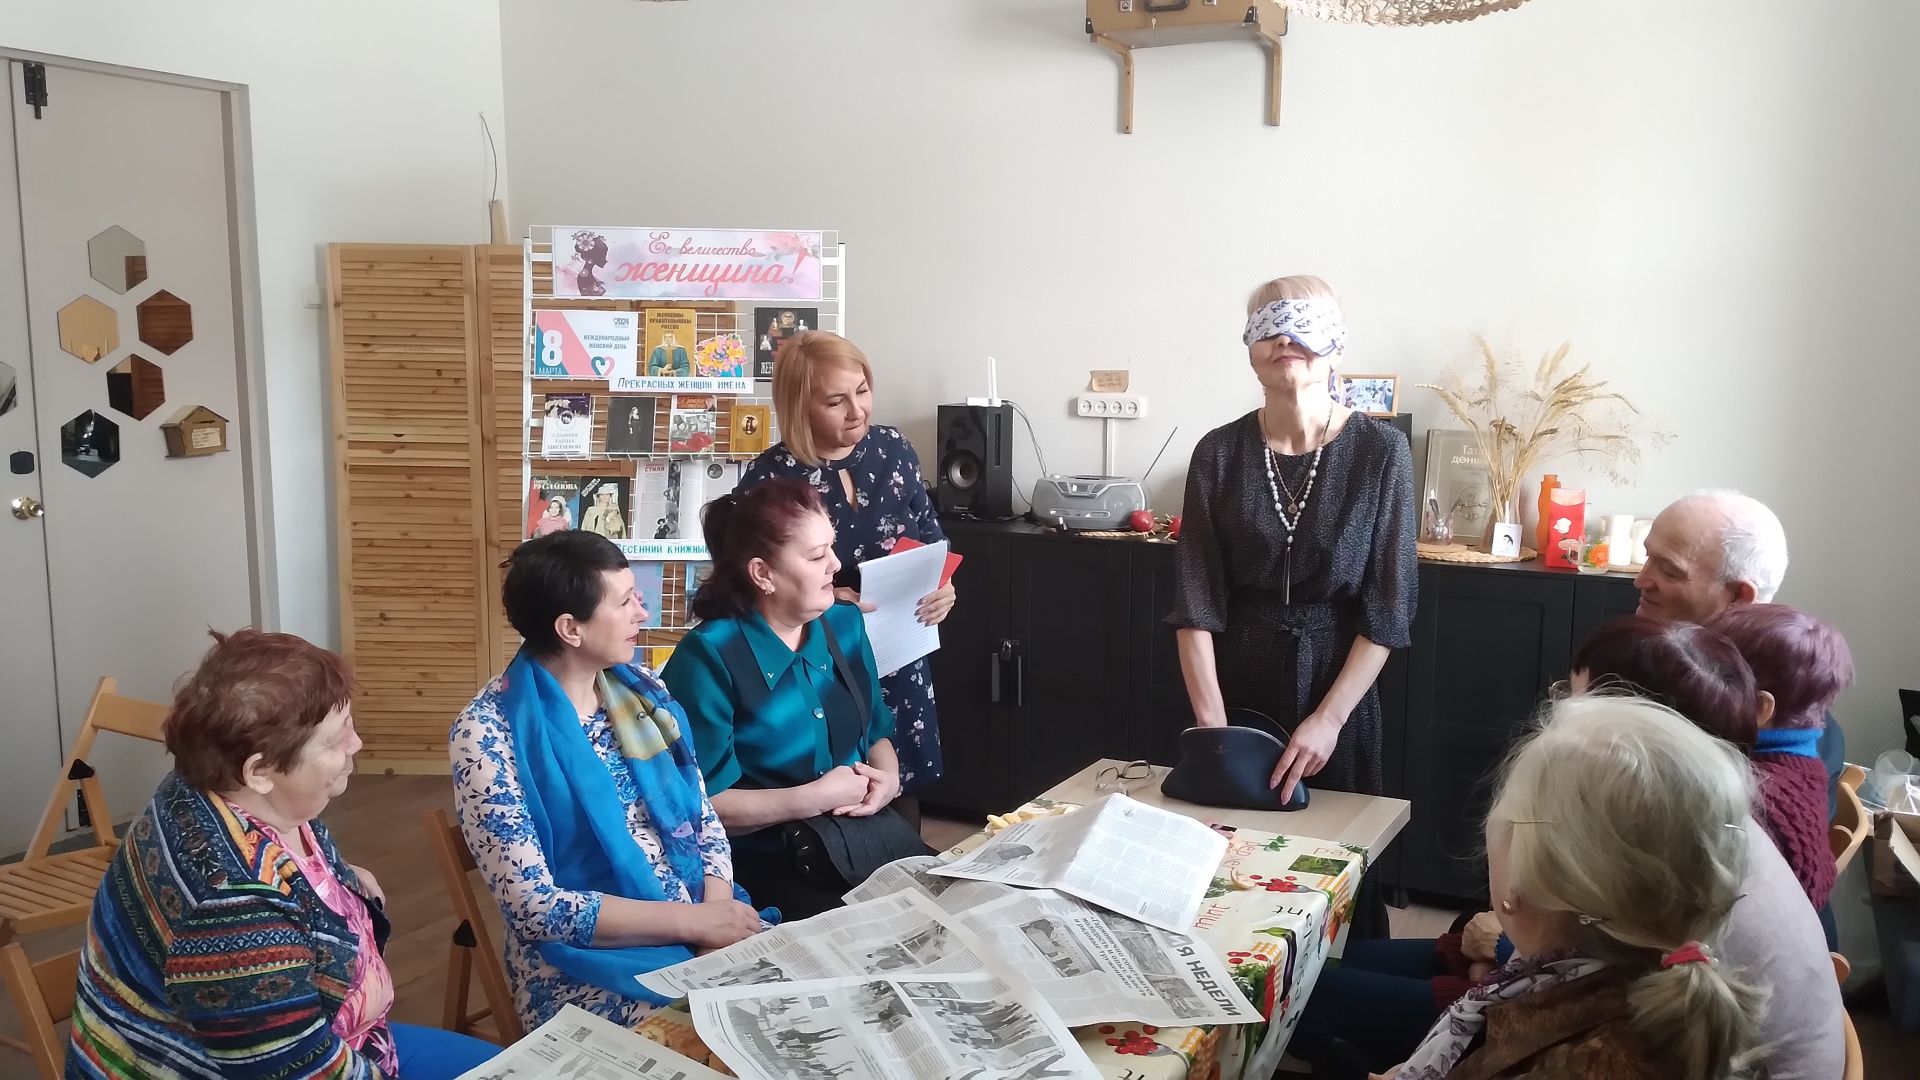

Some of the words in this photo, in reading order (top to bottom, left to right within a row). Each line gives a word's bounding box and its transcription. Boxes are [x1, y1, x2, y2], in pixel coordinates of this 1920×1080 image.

[649, 231, 672, 255] Ее
[614, 248, 806, 298] женщина!
[542, 330, 562, 367] 8
[678, 380, 713, 391] ЖЕНЩИН
[717, 380, 746, 390] ИМЕНА
[1186, 960, 1242, 1016] НЕДЕЛИ
